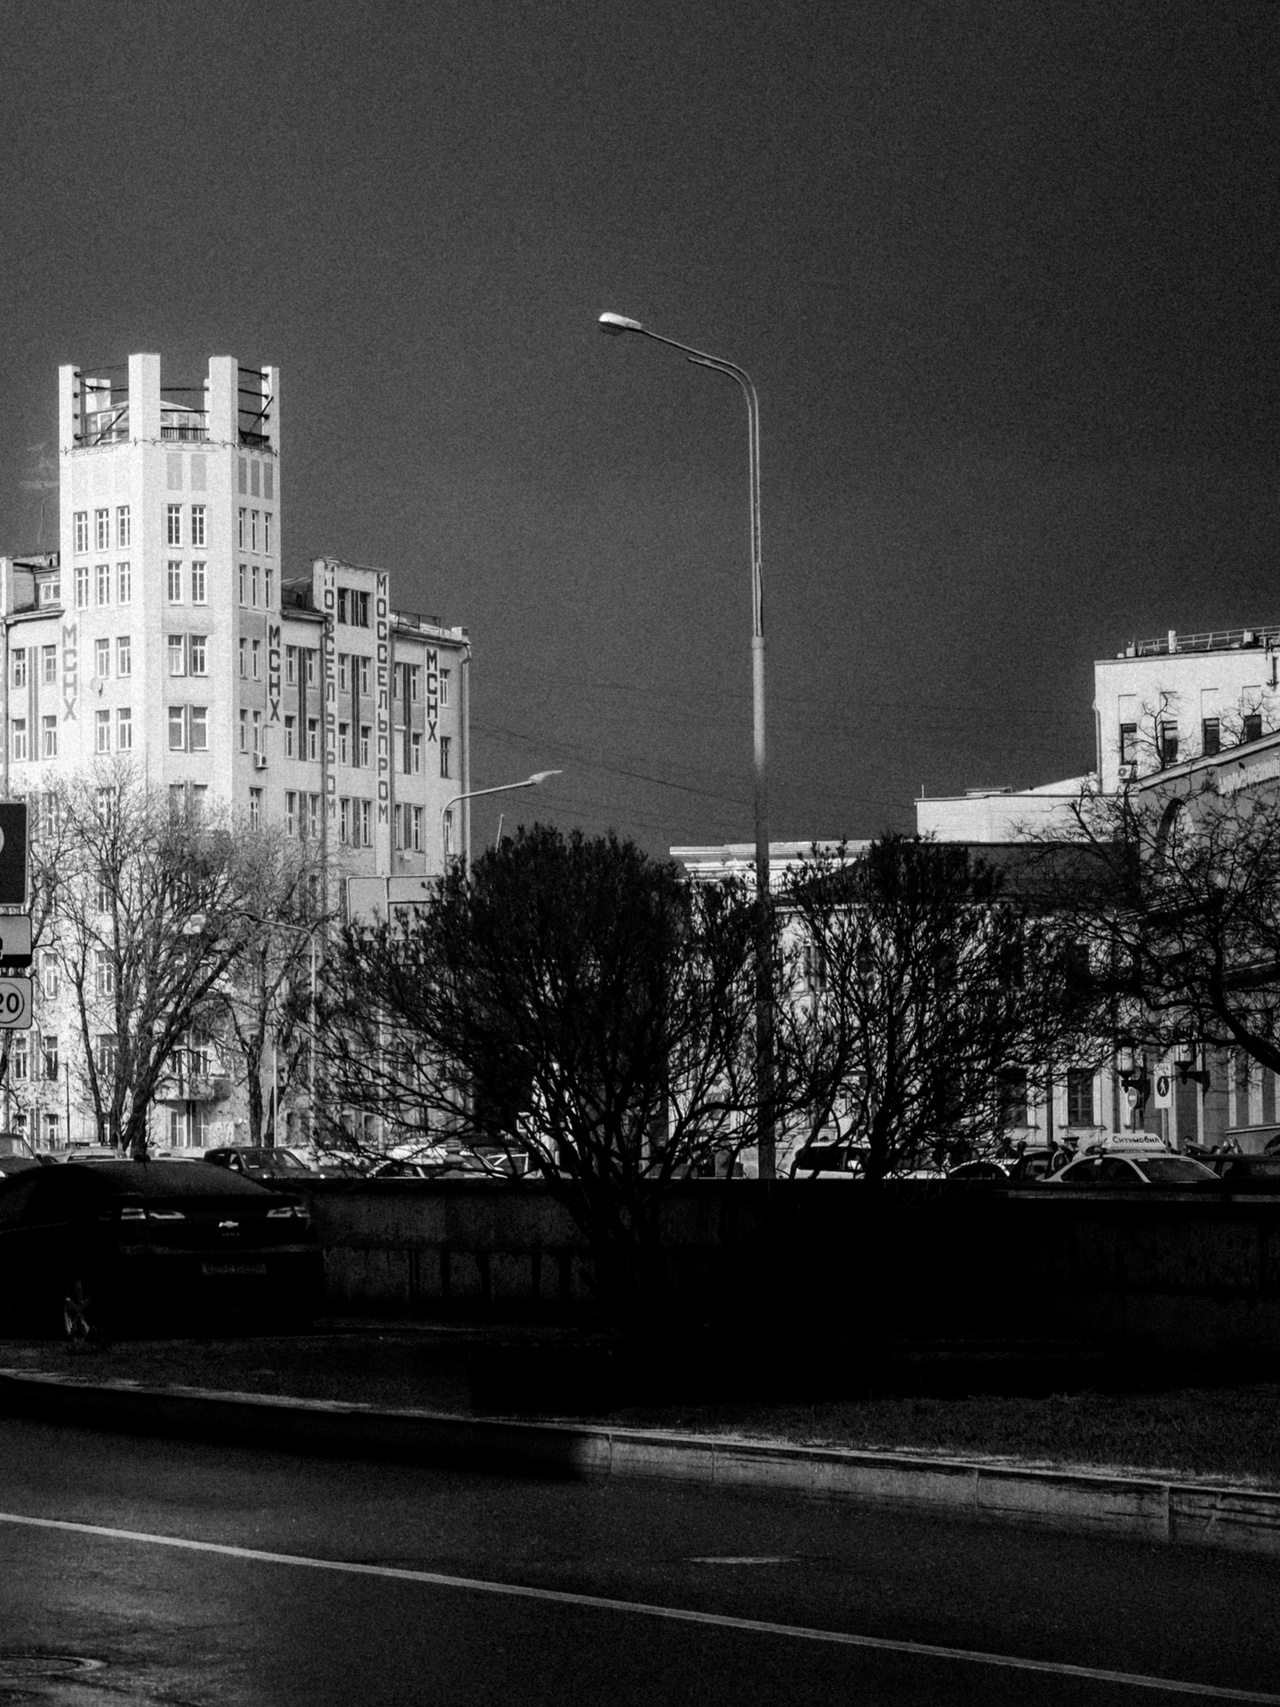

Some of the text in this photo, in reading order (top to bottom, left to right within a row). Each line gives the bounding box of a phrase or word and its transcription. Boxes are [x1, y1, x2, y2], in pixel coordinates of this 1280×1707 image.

[62, 623, 78, 722] МСНХ
[269, 623, 281, 723] МСНХ
[377, 573, 389, 825] МОССЕЛЬПРОМ
[426, 648, 438, 743] МСНХ
